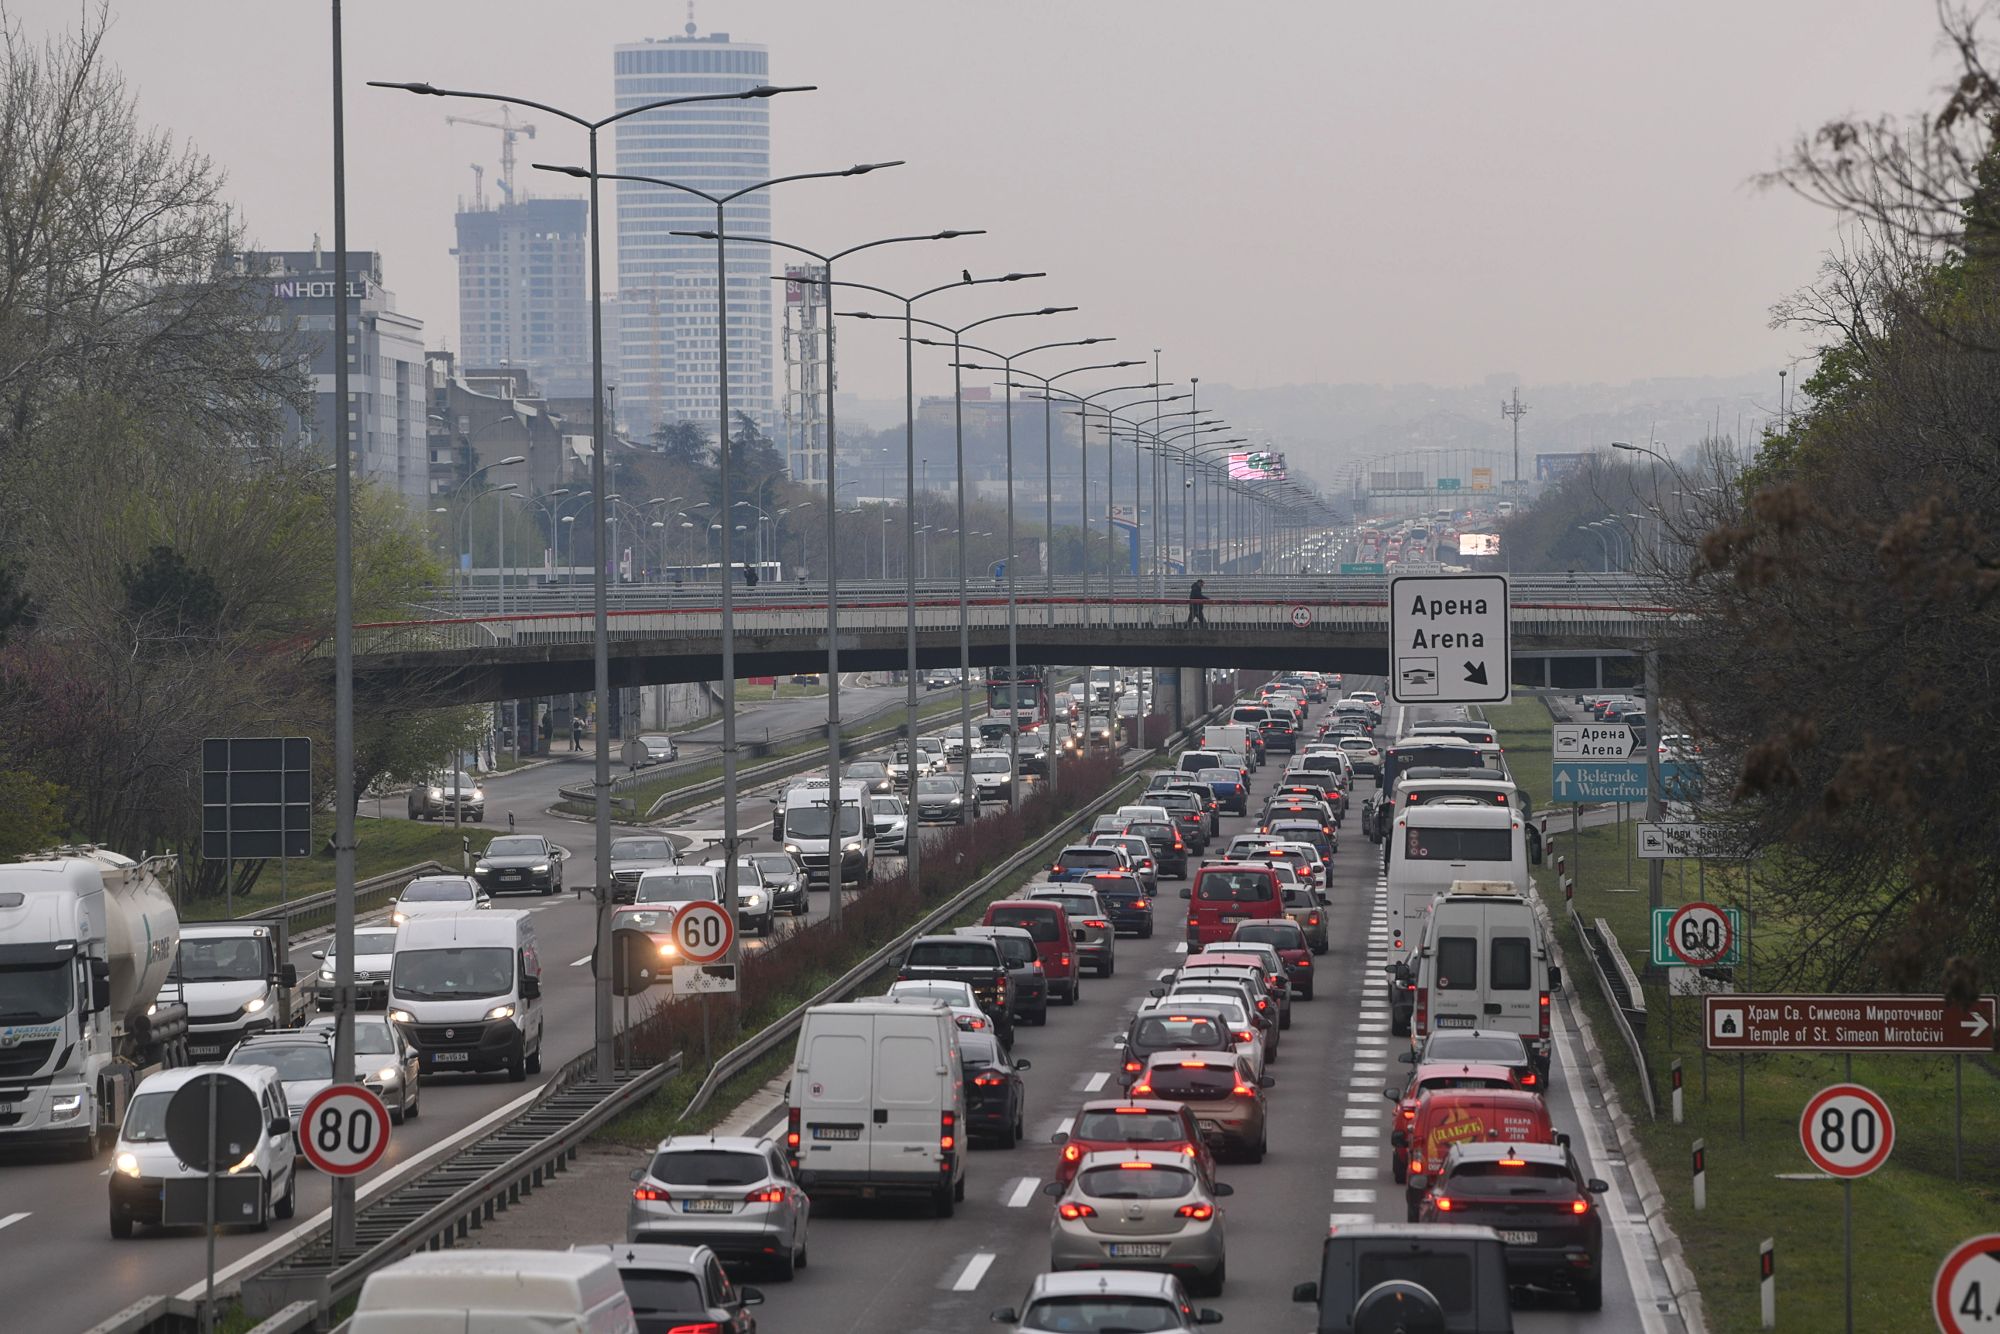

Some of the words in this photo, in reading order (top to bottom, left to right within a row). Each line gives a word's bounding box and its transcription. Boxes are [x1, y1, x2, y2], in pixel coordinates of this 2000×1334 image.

[1411, 595, 1487, 620] Арена
[1411, 628, 1484, 649] Arena
[1581, 728, 1625, 741] Арена
[1581, 744, 1623, 755] Arena
[1577, 769, 1639, 783] Belgrade
[1577, 783, 1648, 796] Waterfron
[684, 916, 720, 947] 60
[1681, 918, 1720, 950] 60
[1748, 1005, 1779, 1024] Храм
[1784, 1005, 1803, 1021] Св.
[1809, 1005, 1861, 1021] Симеона
[1866, 1006, 1944, 1024] Мироточивог
[1748, 1026, 1790, 1045] Temple
[1795, 1026, 1808, 1042] of
[1813, 1026, 1831, 1042] St.
[1836, 1027, 1879, 1042] Simeon
[1884, 1027, 1944, 1042] Mirotočivi
[318, 1107, 372, 1154] 80
[1821, 1107, 1876, 1154] 80
[1960, 1281, 2000, 1321] 4.
